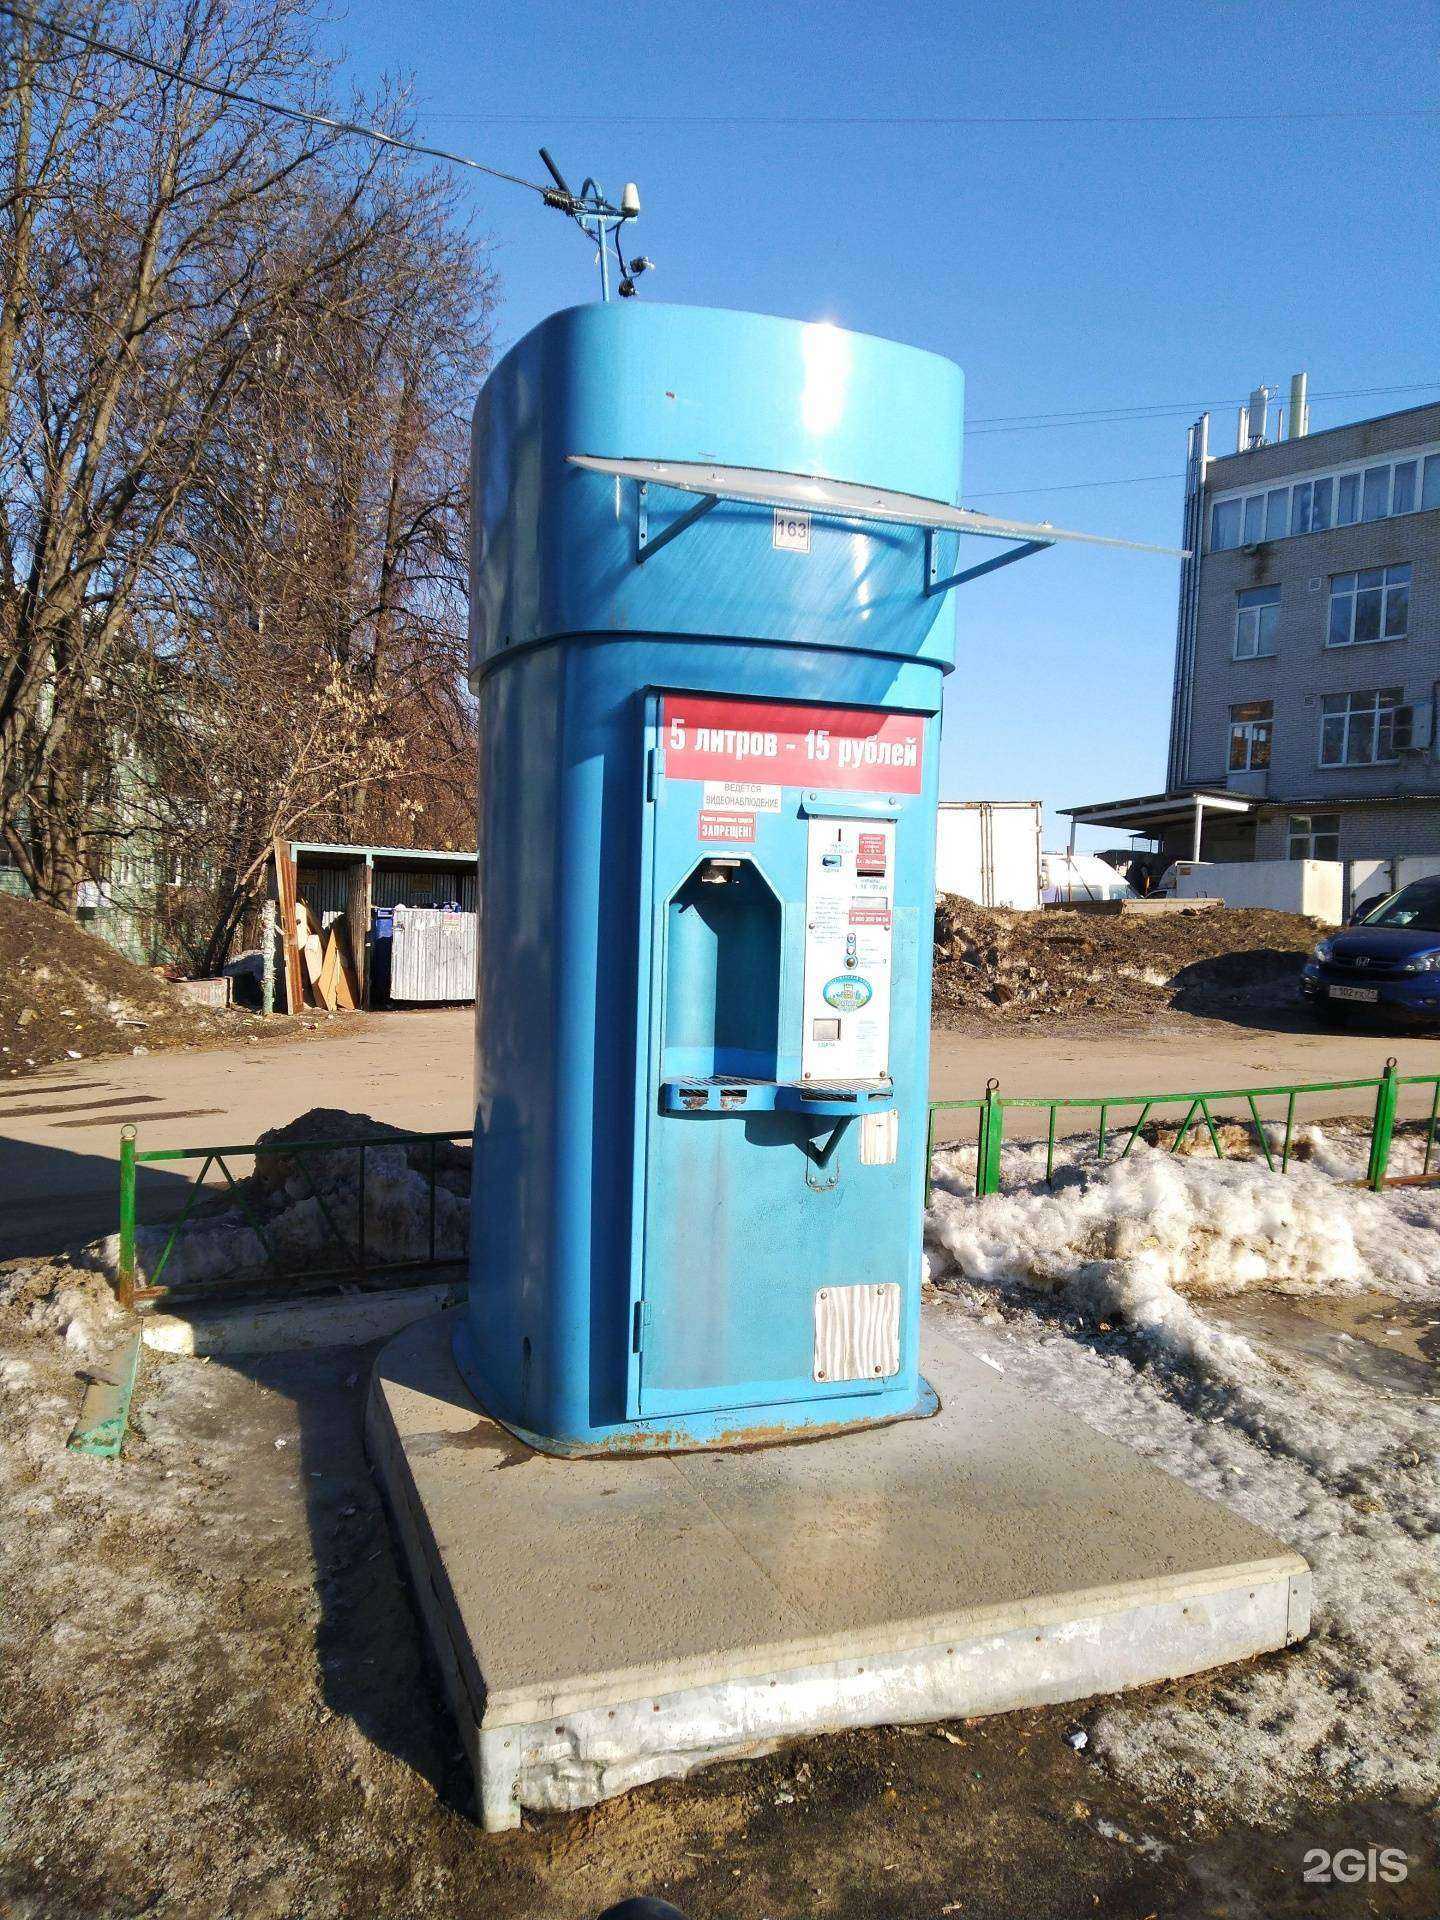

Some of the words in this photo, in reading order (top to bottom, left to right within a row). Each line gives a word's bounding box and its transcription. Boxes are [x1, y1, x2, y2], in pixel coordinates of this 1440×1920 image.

[777, 519, 807, 538] 163
[670, 717, 686, 750] 5
[694, 727, 778, 761] литров
[804, 729, 830, 761] 15
[838, 733, 918, 769] рублей
[724, 783, 762, 793] ВЕДЕТСЯ
[705, 795, 779, 808] ВИДЕОНАБЛЮДЕНИЕ
